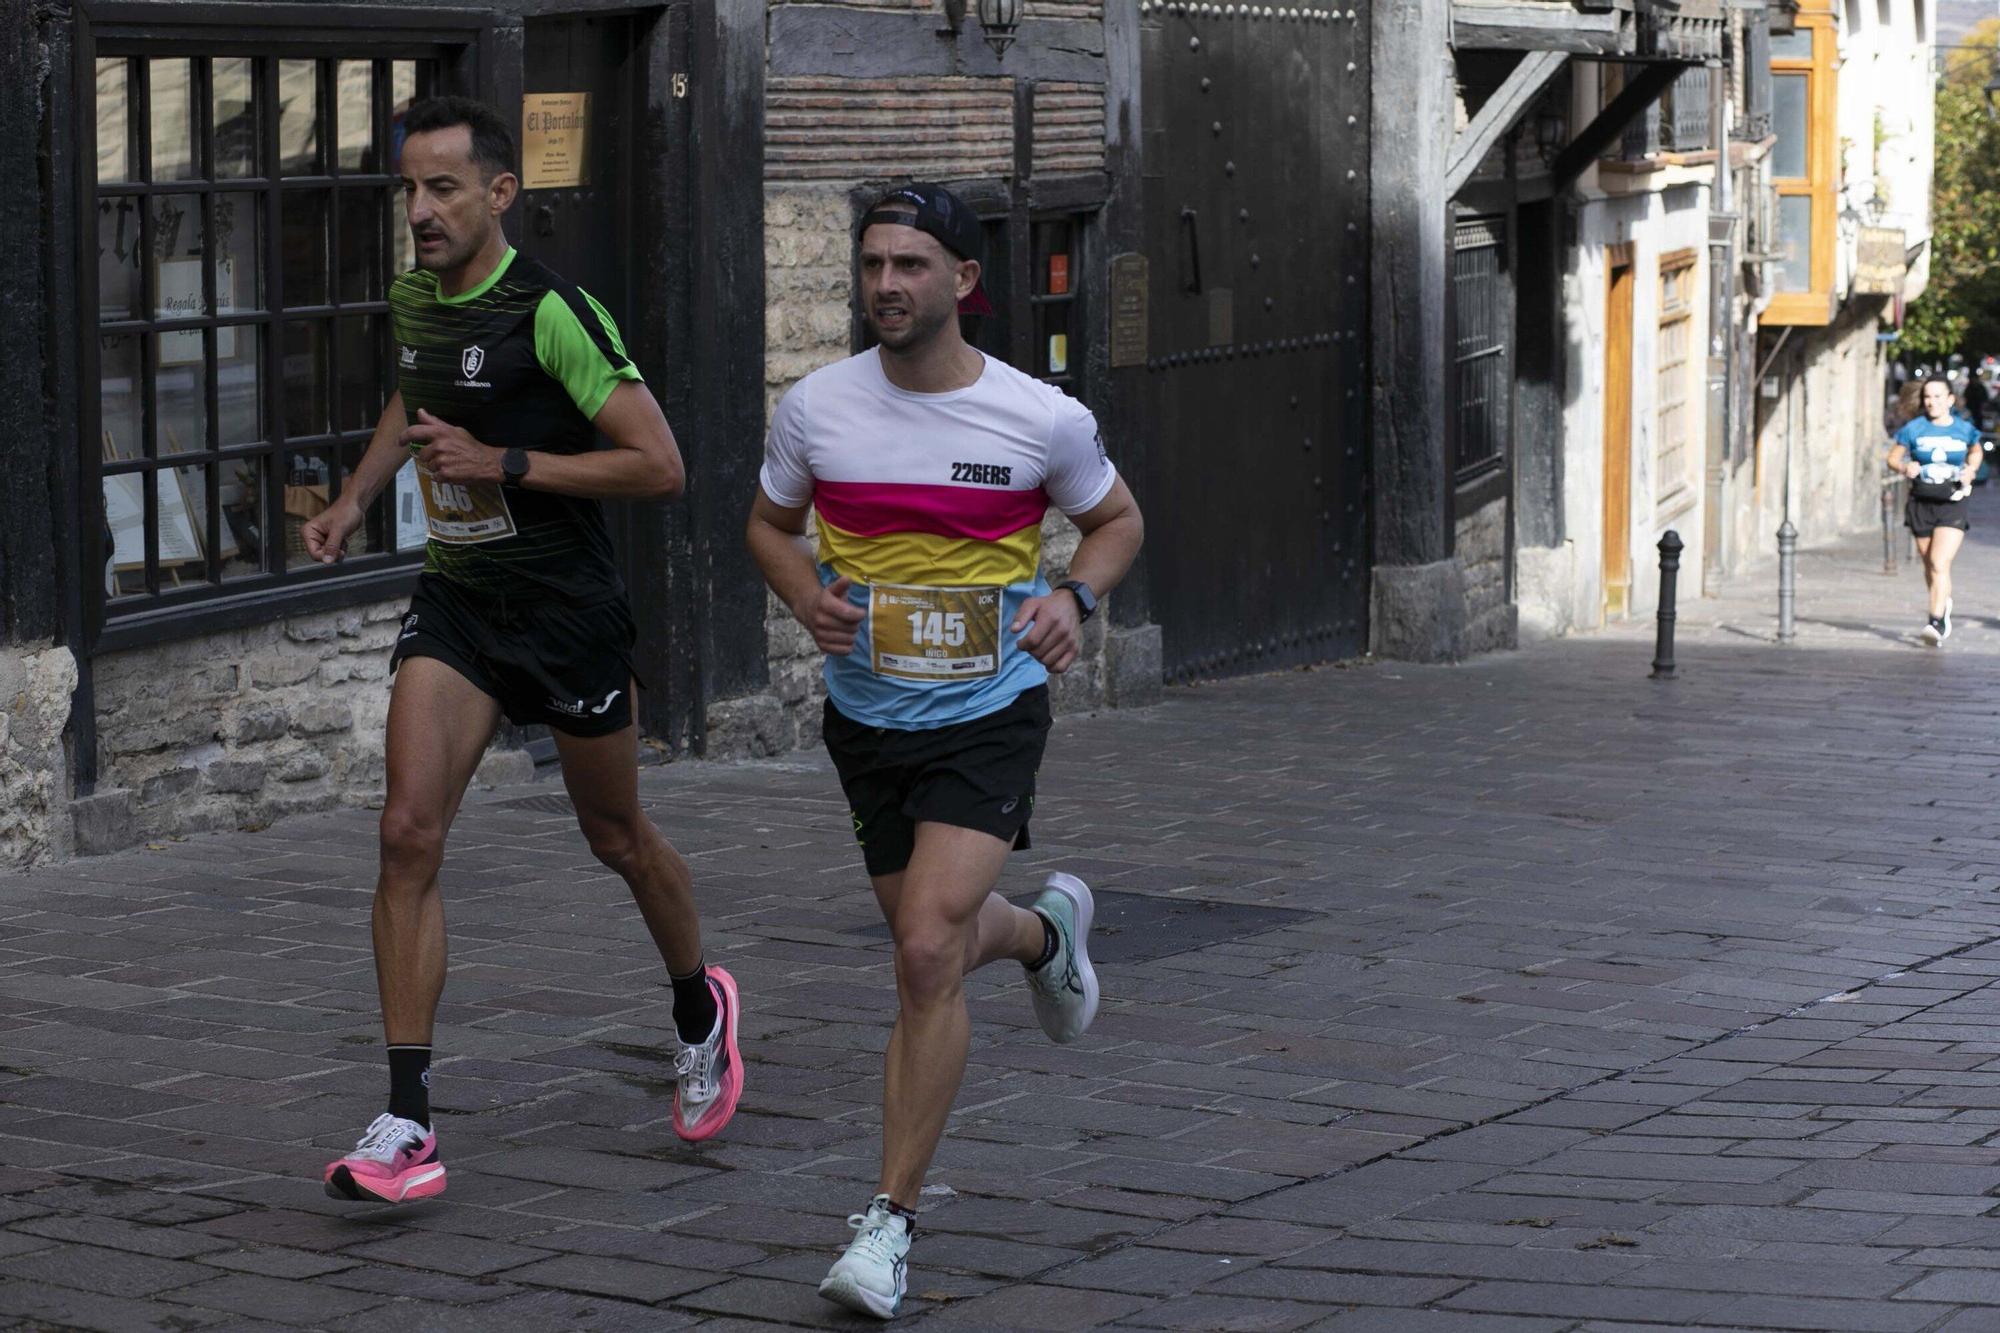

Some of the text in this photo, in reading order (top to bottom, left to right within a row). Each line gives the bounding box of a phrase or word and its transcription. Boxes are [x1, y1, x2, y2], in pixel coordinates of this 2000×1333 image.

[672, 72, 686, 98] 15
[527, 109, 586, 134] El Portalón
[165, 293, 196, 316] Regala
[951, 462, 1011, 486] 226ERS
[431, 480, 474, 513] 446
[907, 611, 966, 646] 145
